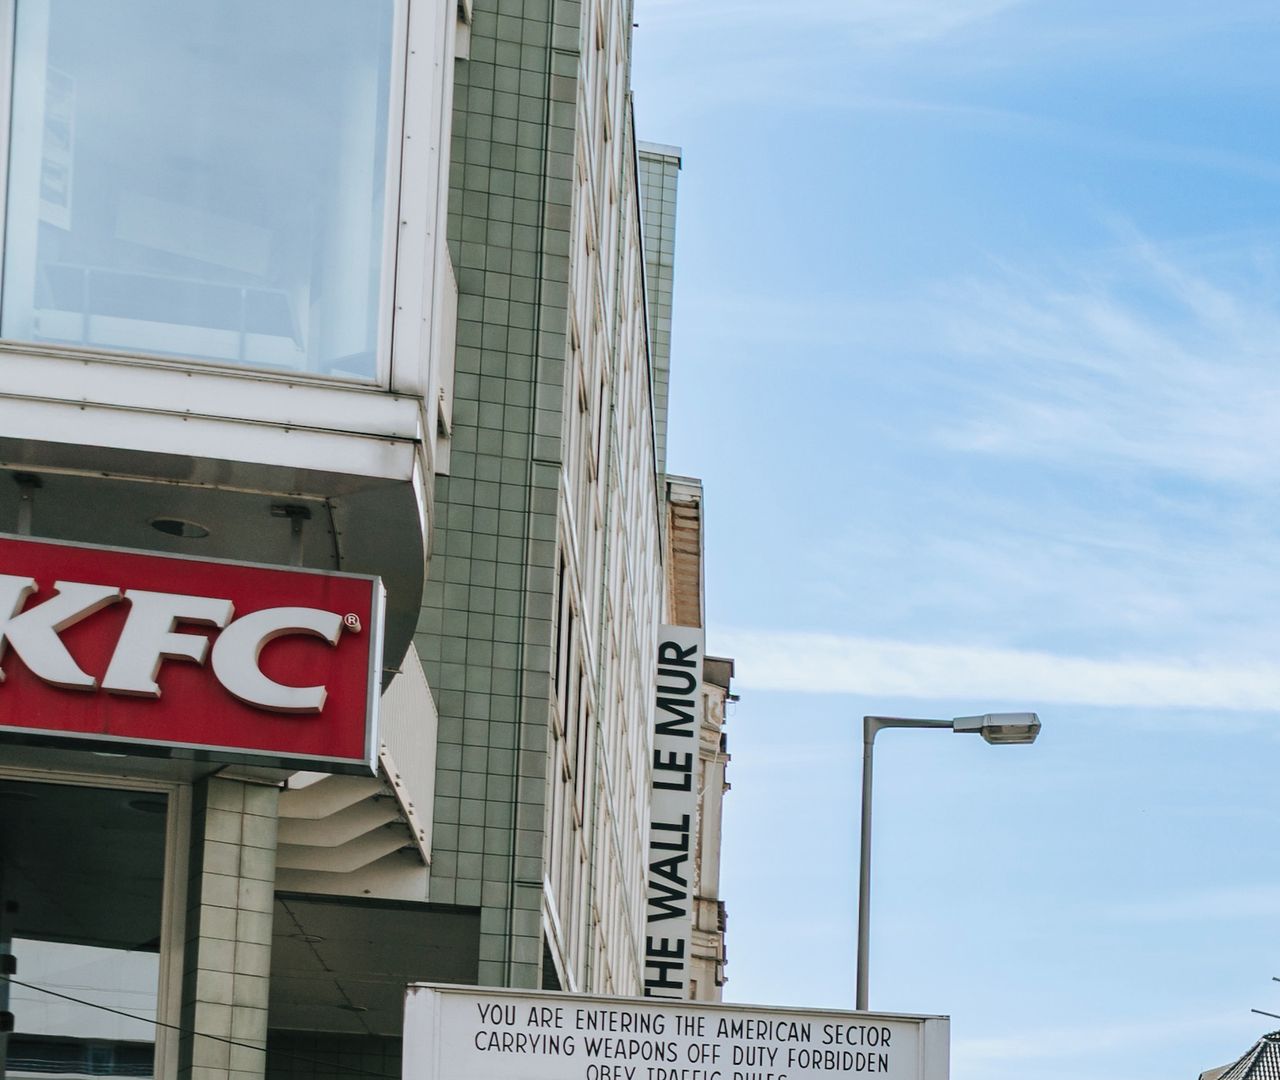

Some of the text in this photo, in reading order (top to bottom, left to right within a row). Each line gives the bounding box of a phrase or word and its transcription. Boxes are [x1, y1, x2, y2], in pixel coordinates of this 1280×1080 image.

[0, 573, 343, 713] KFC
[655, 641, 698, 738] MUR
[652, 749, 693, 792] LE
[648, 814, 690, 923] WALL
[475, 1031, 888, 1072] CARRYING WEAPONS OFF DUTY FORBIDDEN
[478, 1003, 891, 1047] YOU ARE ENTERING THE AMERICAN SECTOR
